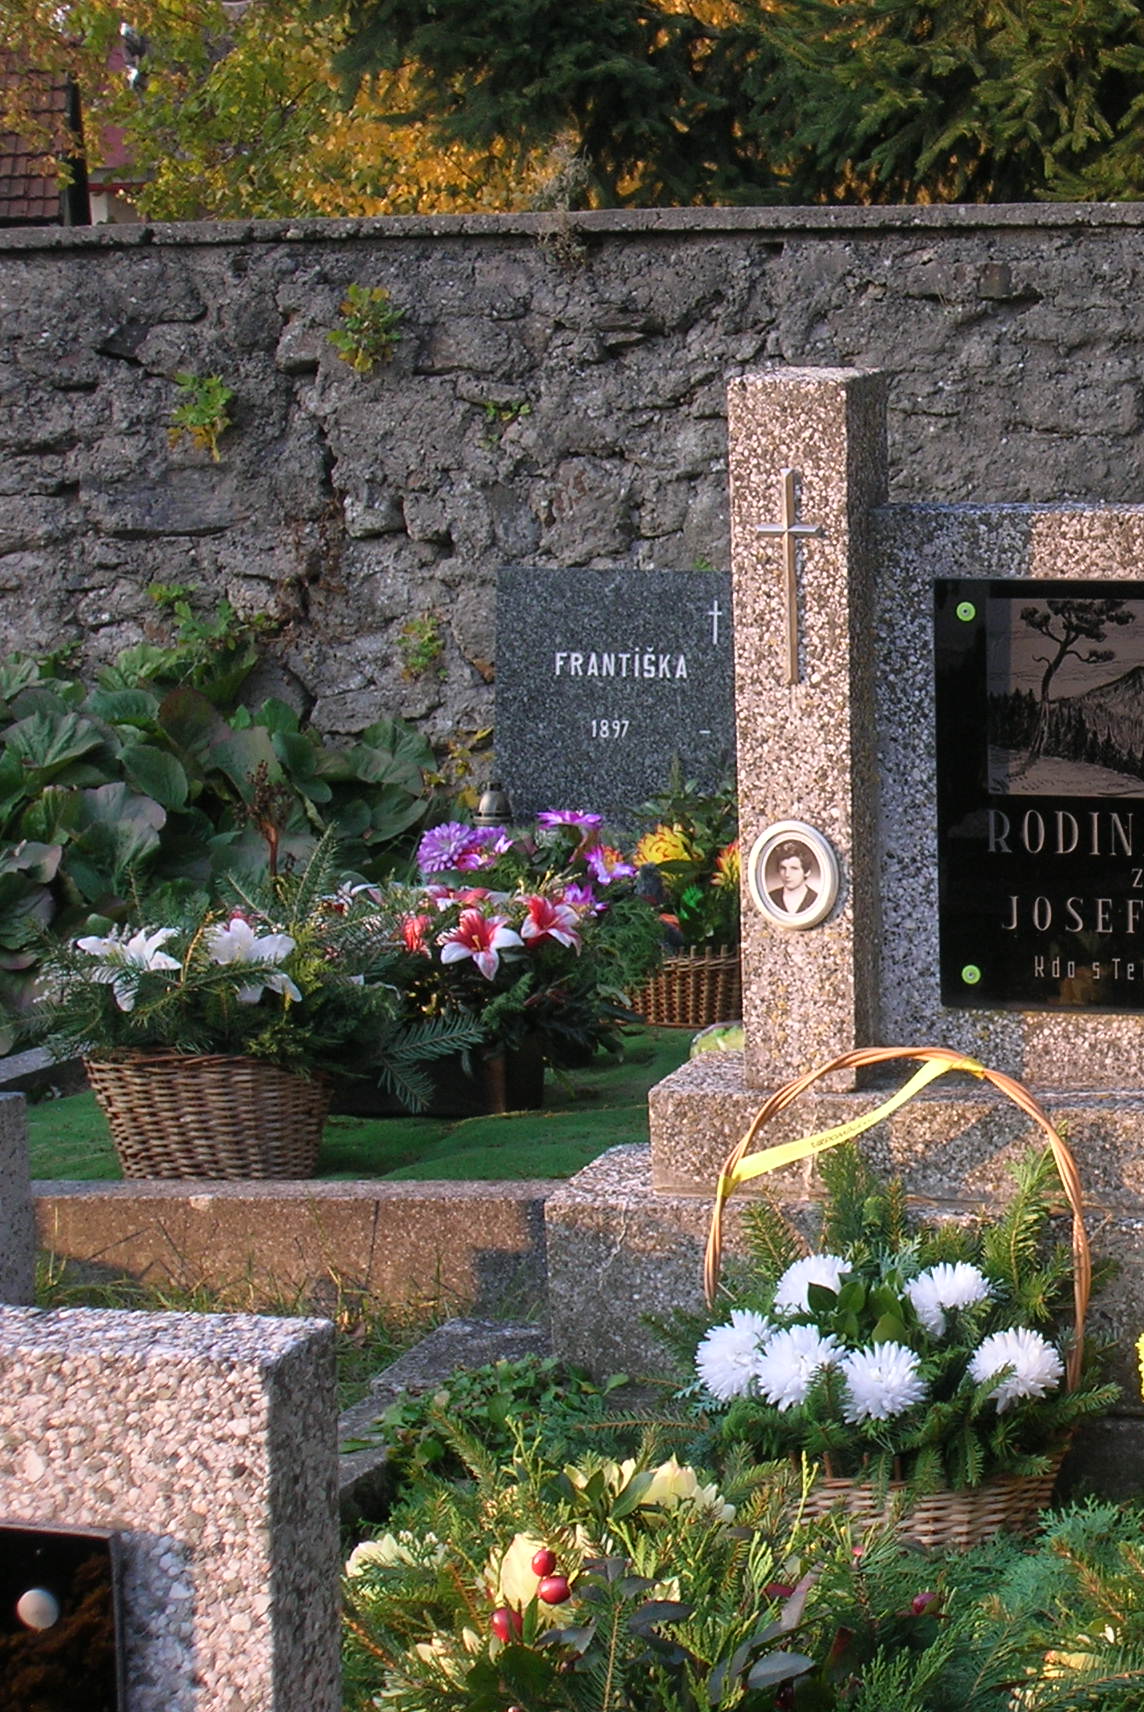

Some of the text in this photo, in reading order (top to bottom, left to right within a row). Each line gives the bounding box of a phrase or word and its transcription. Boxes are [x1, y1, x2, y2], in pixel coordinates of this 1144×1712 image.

[591, 719, 630, 738] 1897
[1001, 895, 1144, 934] JOSEF
[1034, 956, 1076, 980] Kdo
